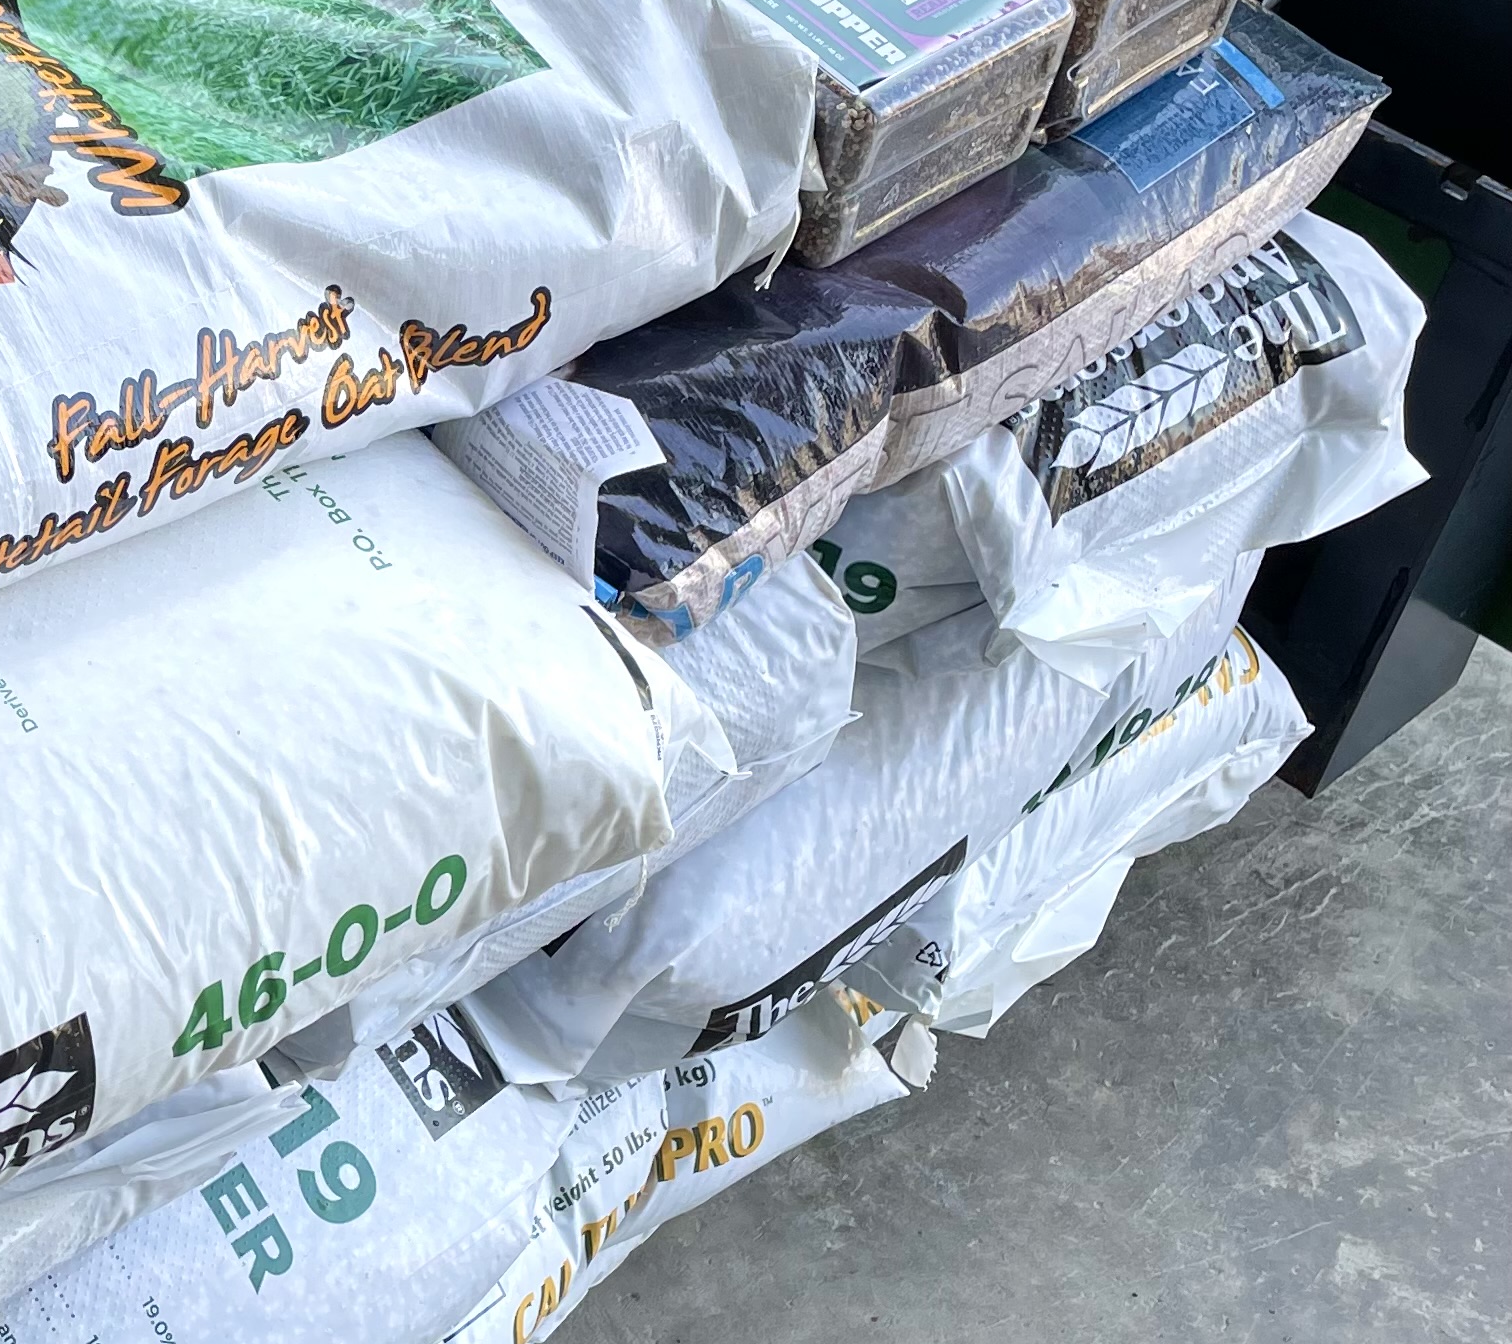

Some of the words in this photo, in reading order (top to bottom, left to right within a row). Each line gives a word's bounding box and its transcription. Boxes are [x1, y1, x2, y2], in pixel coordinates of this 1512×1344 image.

[48, 283, 354, 484] Fall-Harvest
[138, 408, 311, 519] Forage
[318, 348, 403, 431] Oat
[396, 285, 552, 397] Blend
[261, 474, 292, 503] Th
[282, 463, 309, 484] 11
[305, 483, 353, 526] Box
[352, 527, 394, 572] P.O.
[810, 539, 898, 616] 19
[172, 854, 468, 1060] 46-0-0
[721, 977, 818, 1048] The
[268, 1083, 378, 1225] 19
[601, 1145, 627, 1178] 50
[623, 1126, 660, 1157] lbs.
[654, 1099, 767, 1184] PRO
